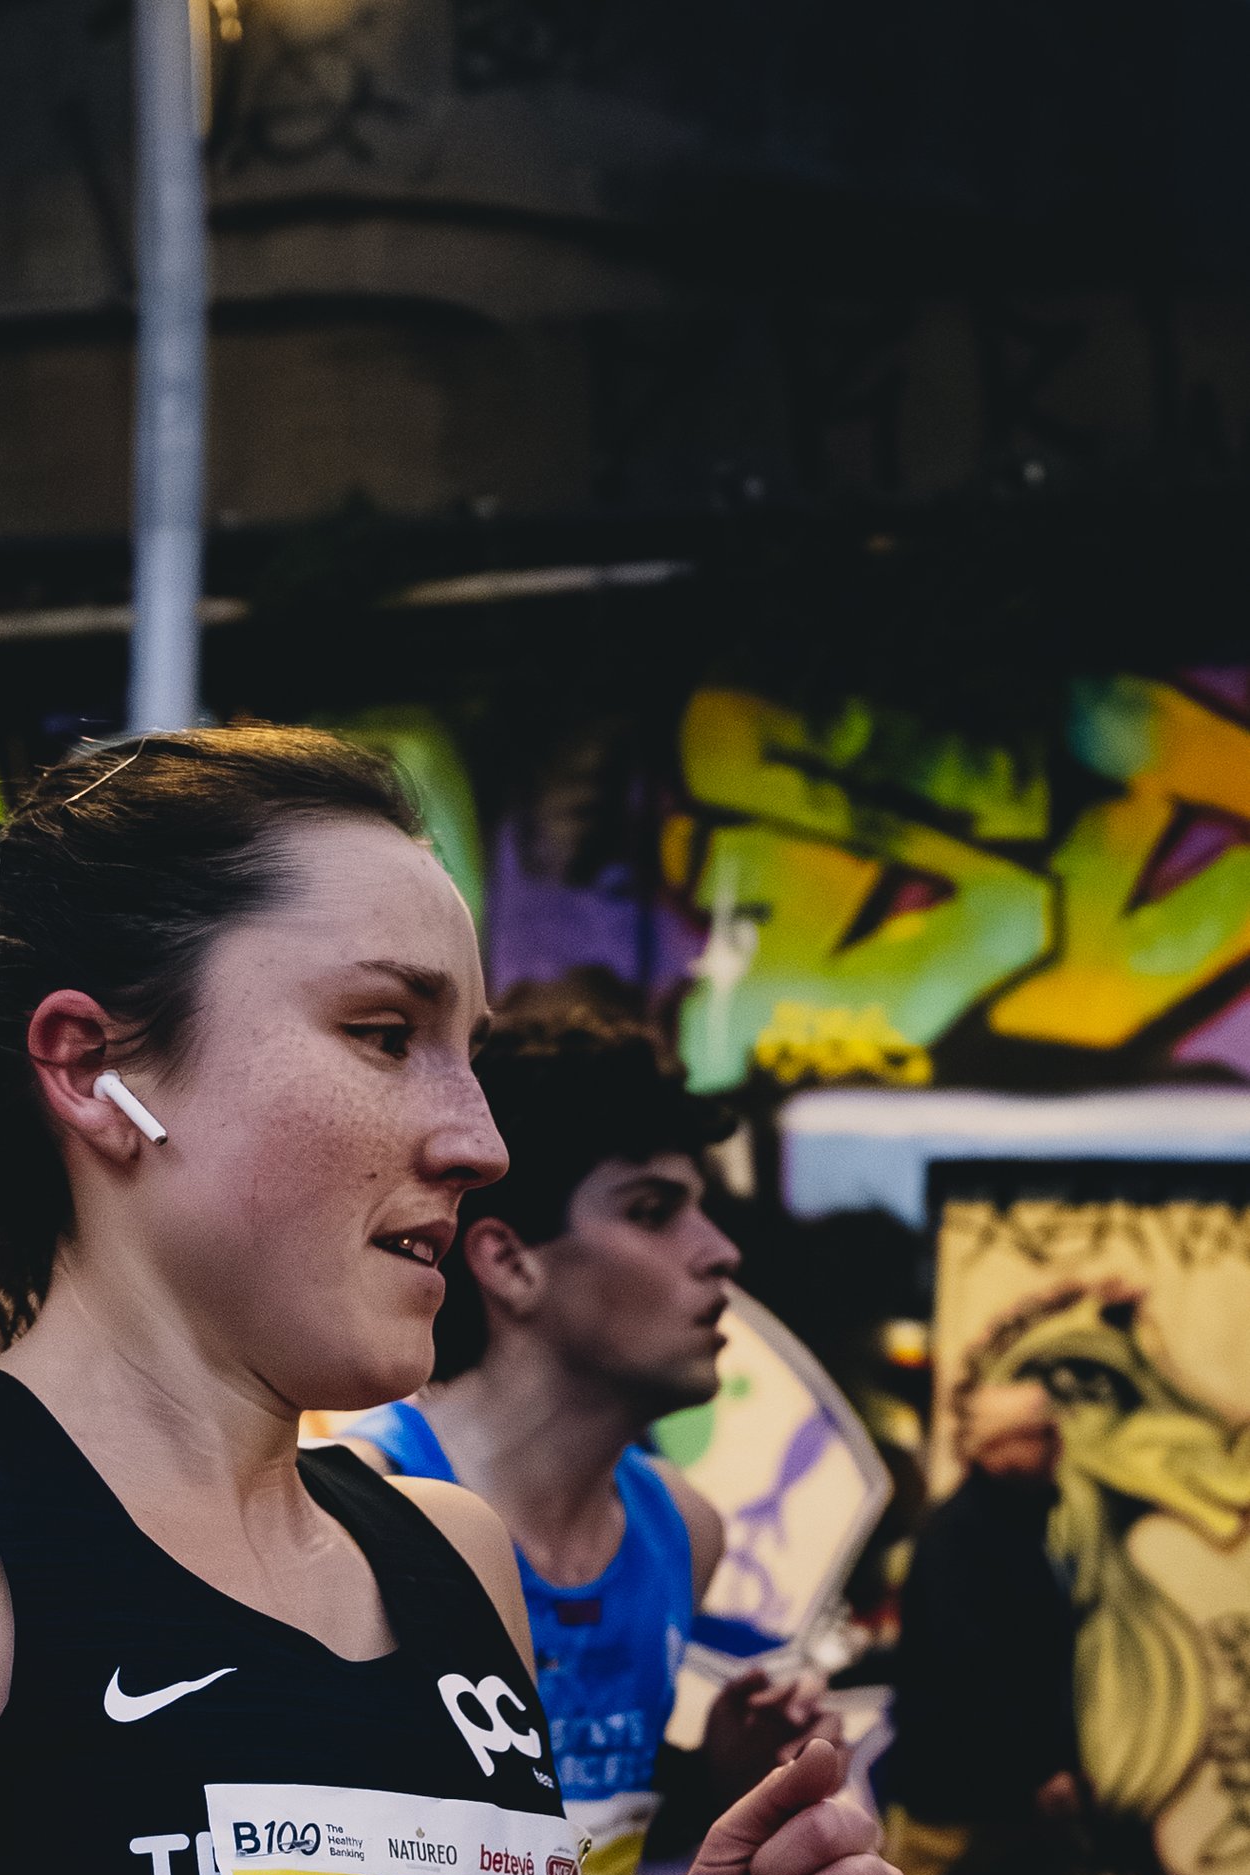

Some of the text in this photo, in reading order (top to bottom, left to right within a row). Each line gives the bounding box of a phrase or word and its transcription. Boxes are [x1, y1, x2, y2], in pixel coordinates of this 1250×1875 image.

[326, 1824, 344, 1834] The
[233, 1820, 321, 1856] B100
[327, 1835, 364, 1848] Healthy
[329, 1847, 365, 1862] Banking
[387, 1838, 458, 1866] NATUREO
